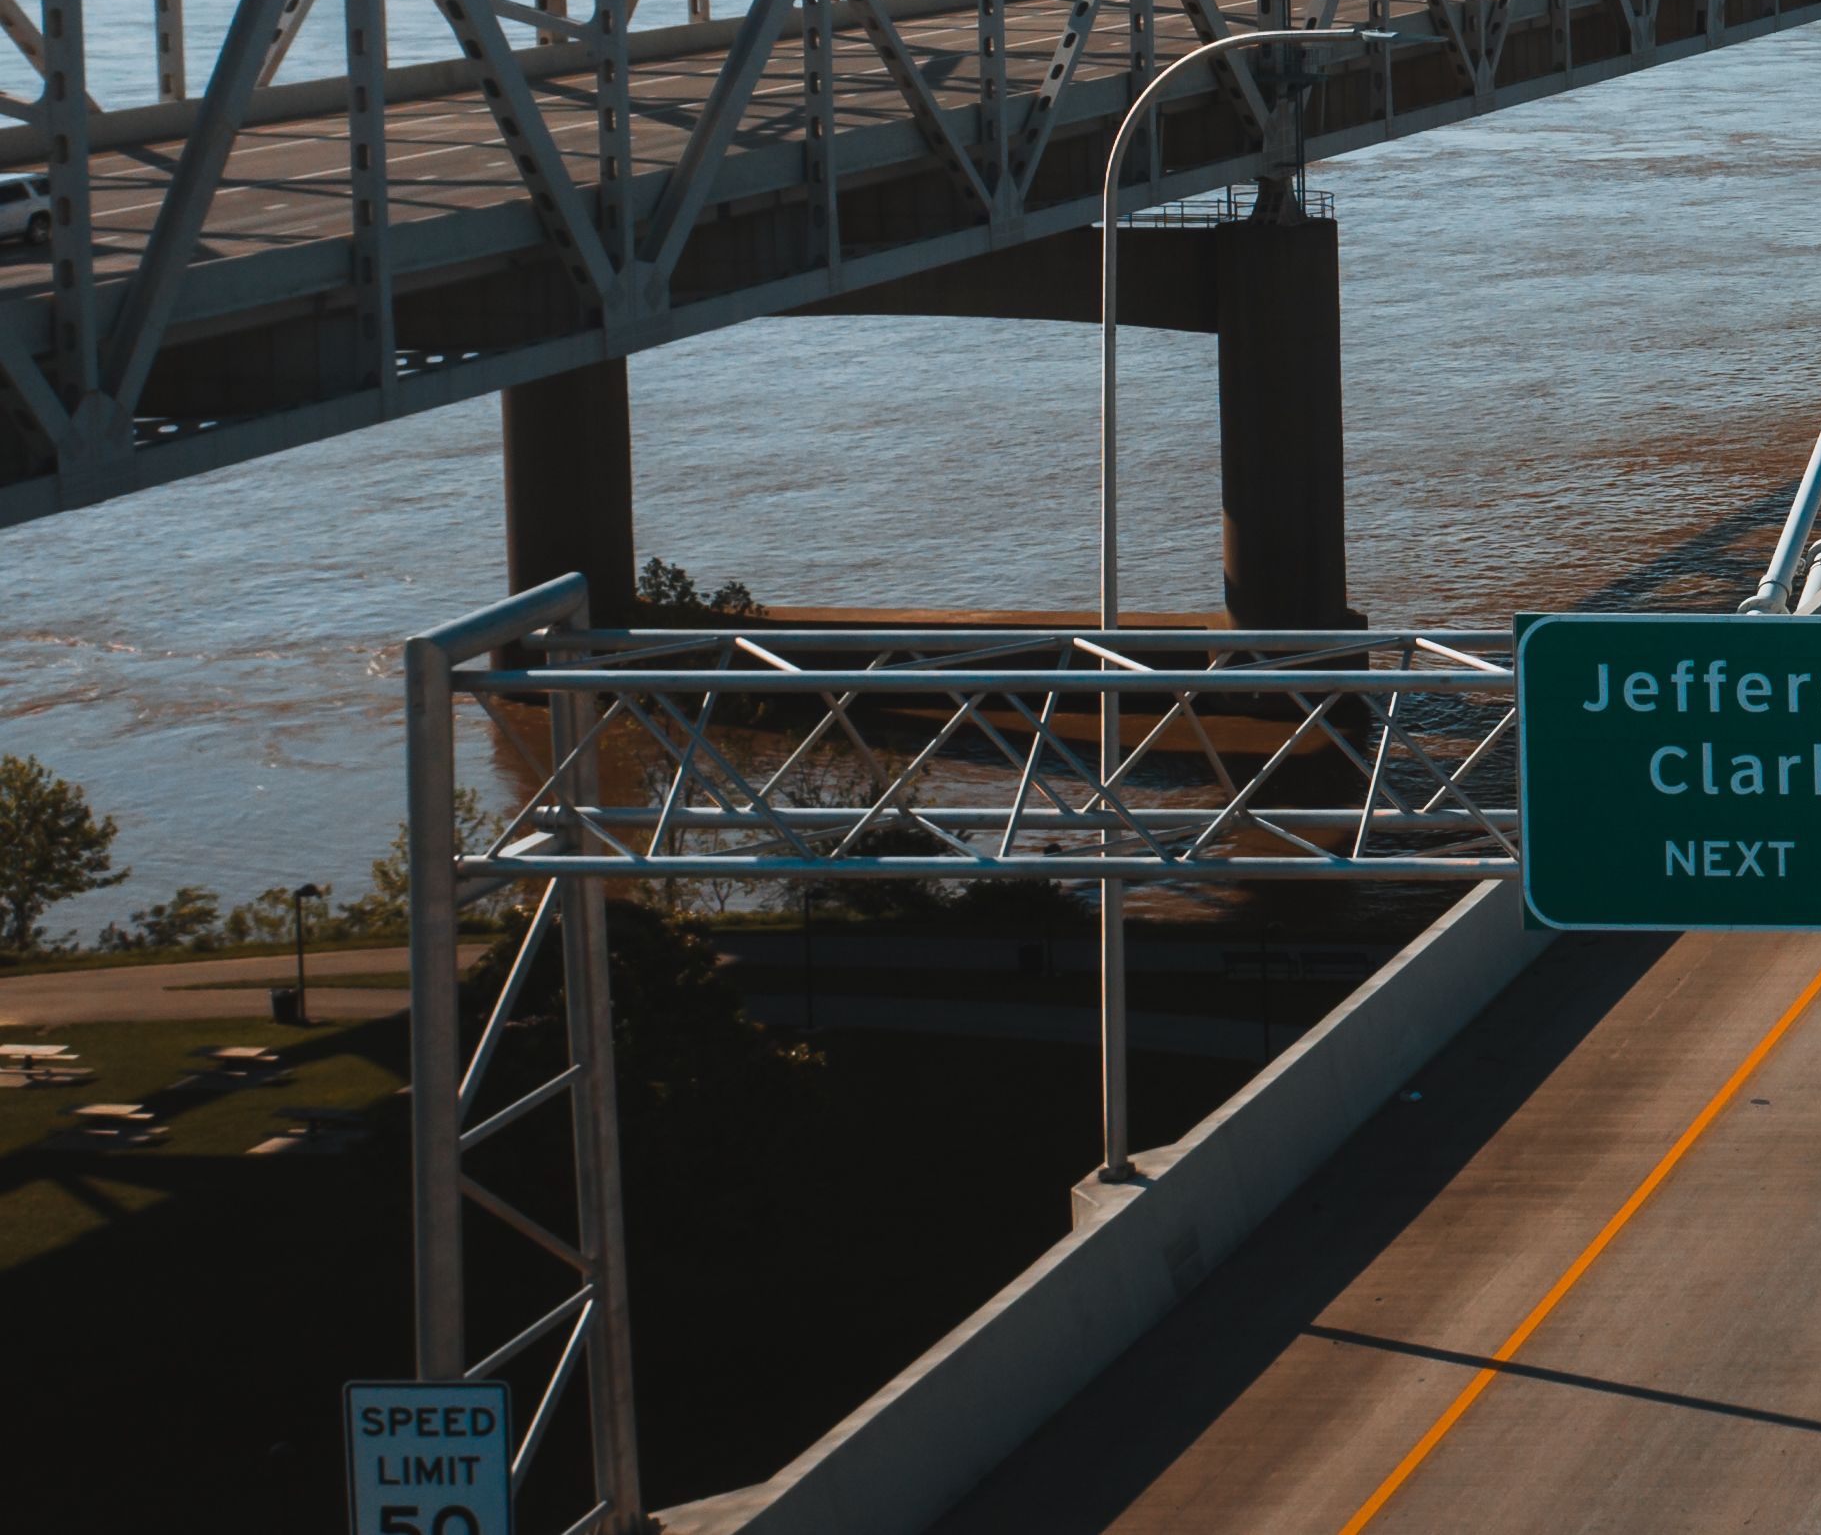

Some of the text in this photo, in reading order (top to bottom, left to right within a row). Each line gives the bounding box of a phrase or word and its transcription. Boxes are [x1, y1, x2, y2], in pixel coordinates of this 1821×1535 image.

[1666, 841, 1794, 876] NEXT
[362, 1407, 495, 1437] SPEED
[378, 1456, 480, 1485] LIMIT
